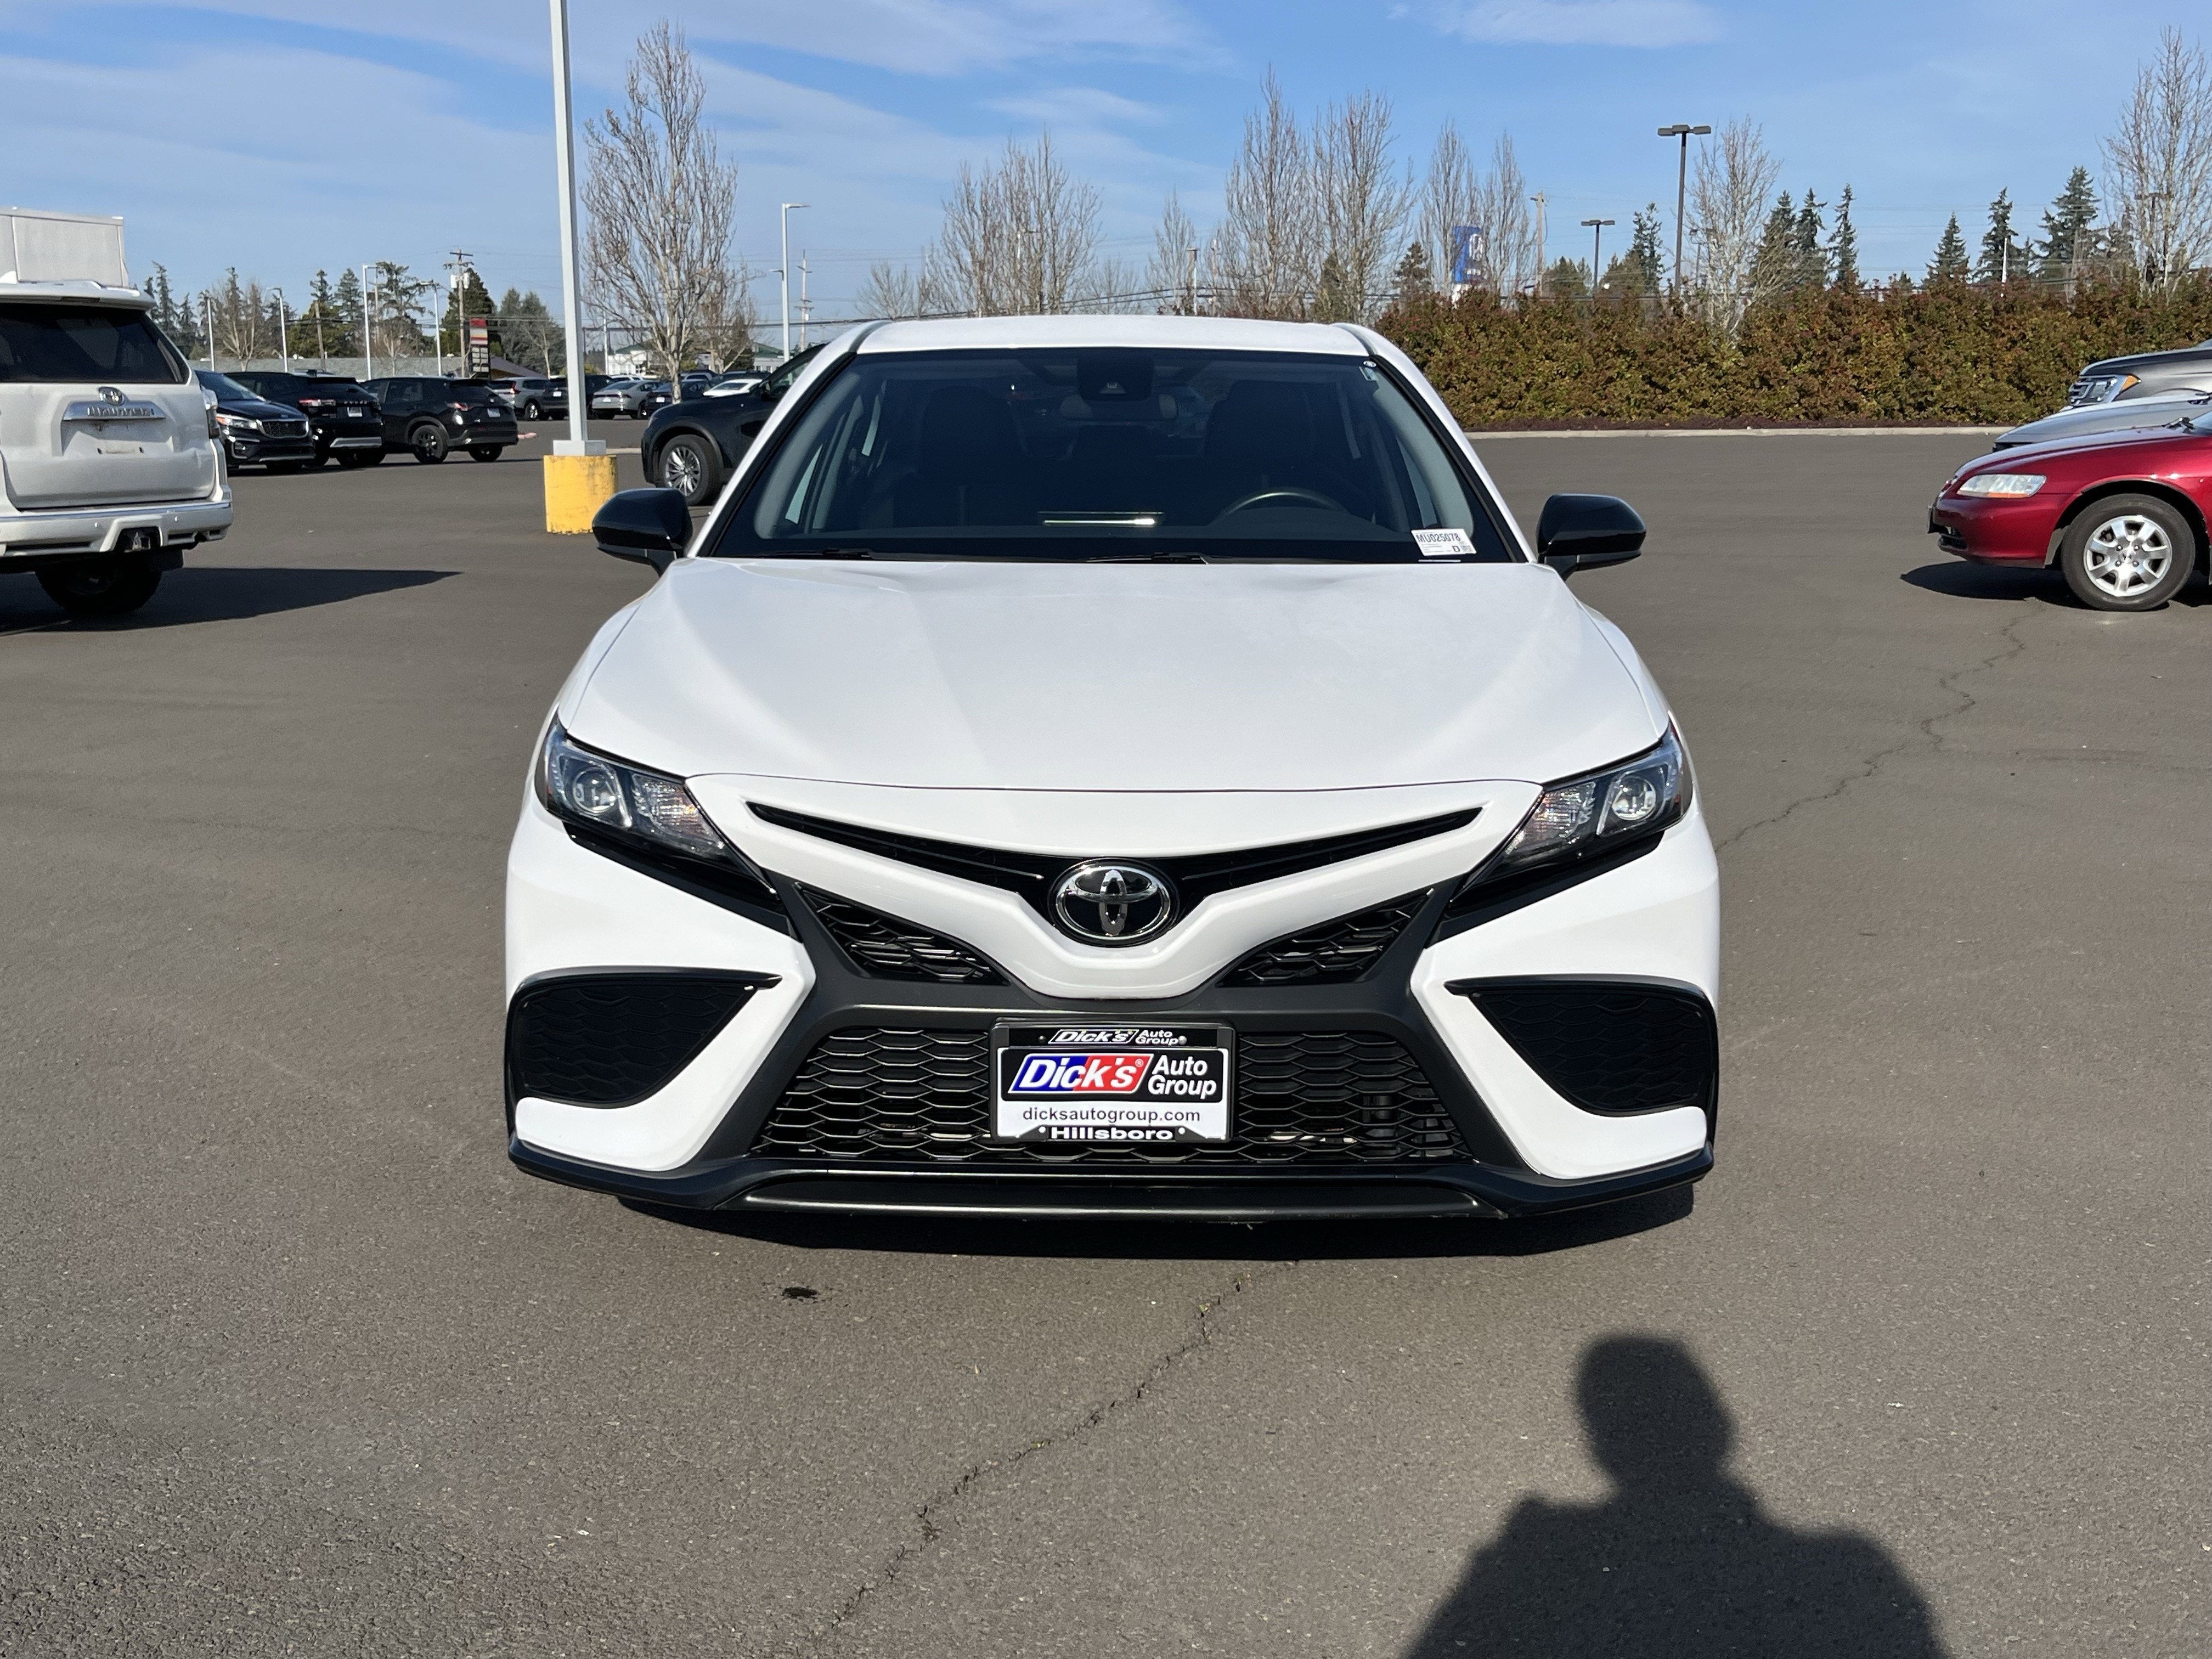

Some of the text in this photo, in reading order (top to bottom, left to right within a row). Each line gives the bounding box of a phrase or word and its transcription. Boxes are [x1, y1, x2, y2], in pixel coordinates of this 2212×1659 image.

[1135, 1036, 1179, 1046] Group
[1139, 1029, 1173, 1038] Auto
[1152, 1055, 1207, 1076] Auto
[1148, 1075, 1216, 1099] Group
[1023, 1107, 1200, 1124] dicksautogroup.com
[1051, 1127, 1173, 1140] Hillsboro
